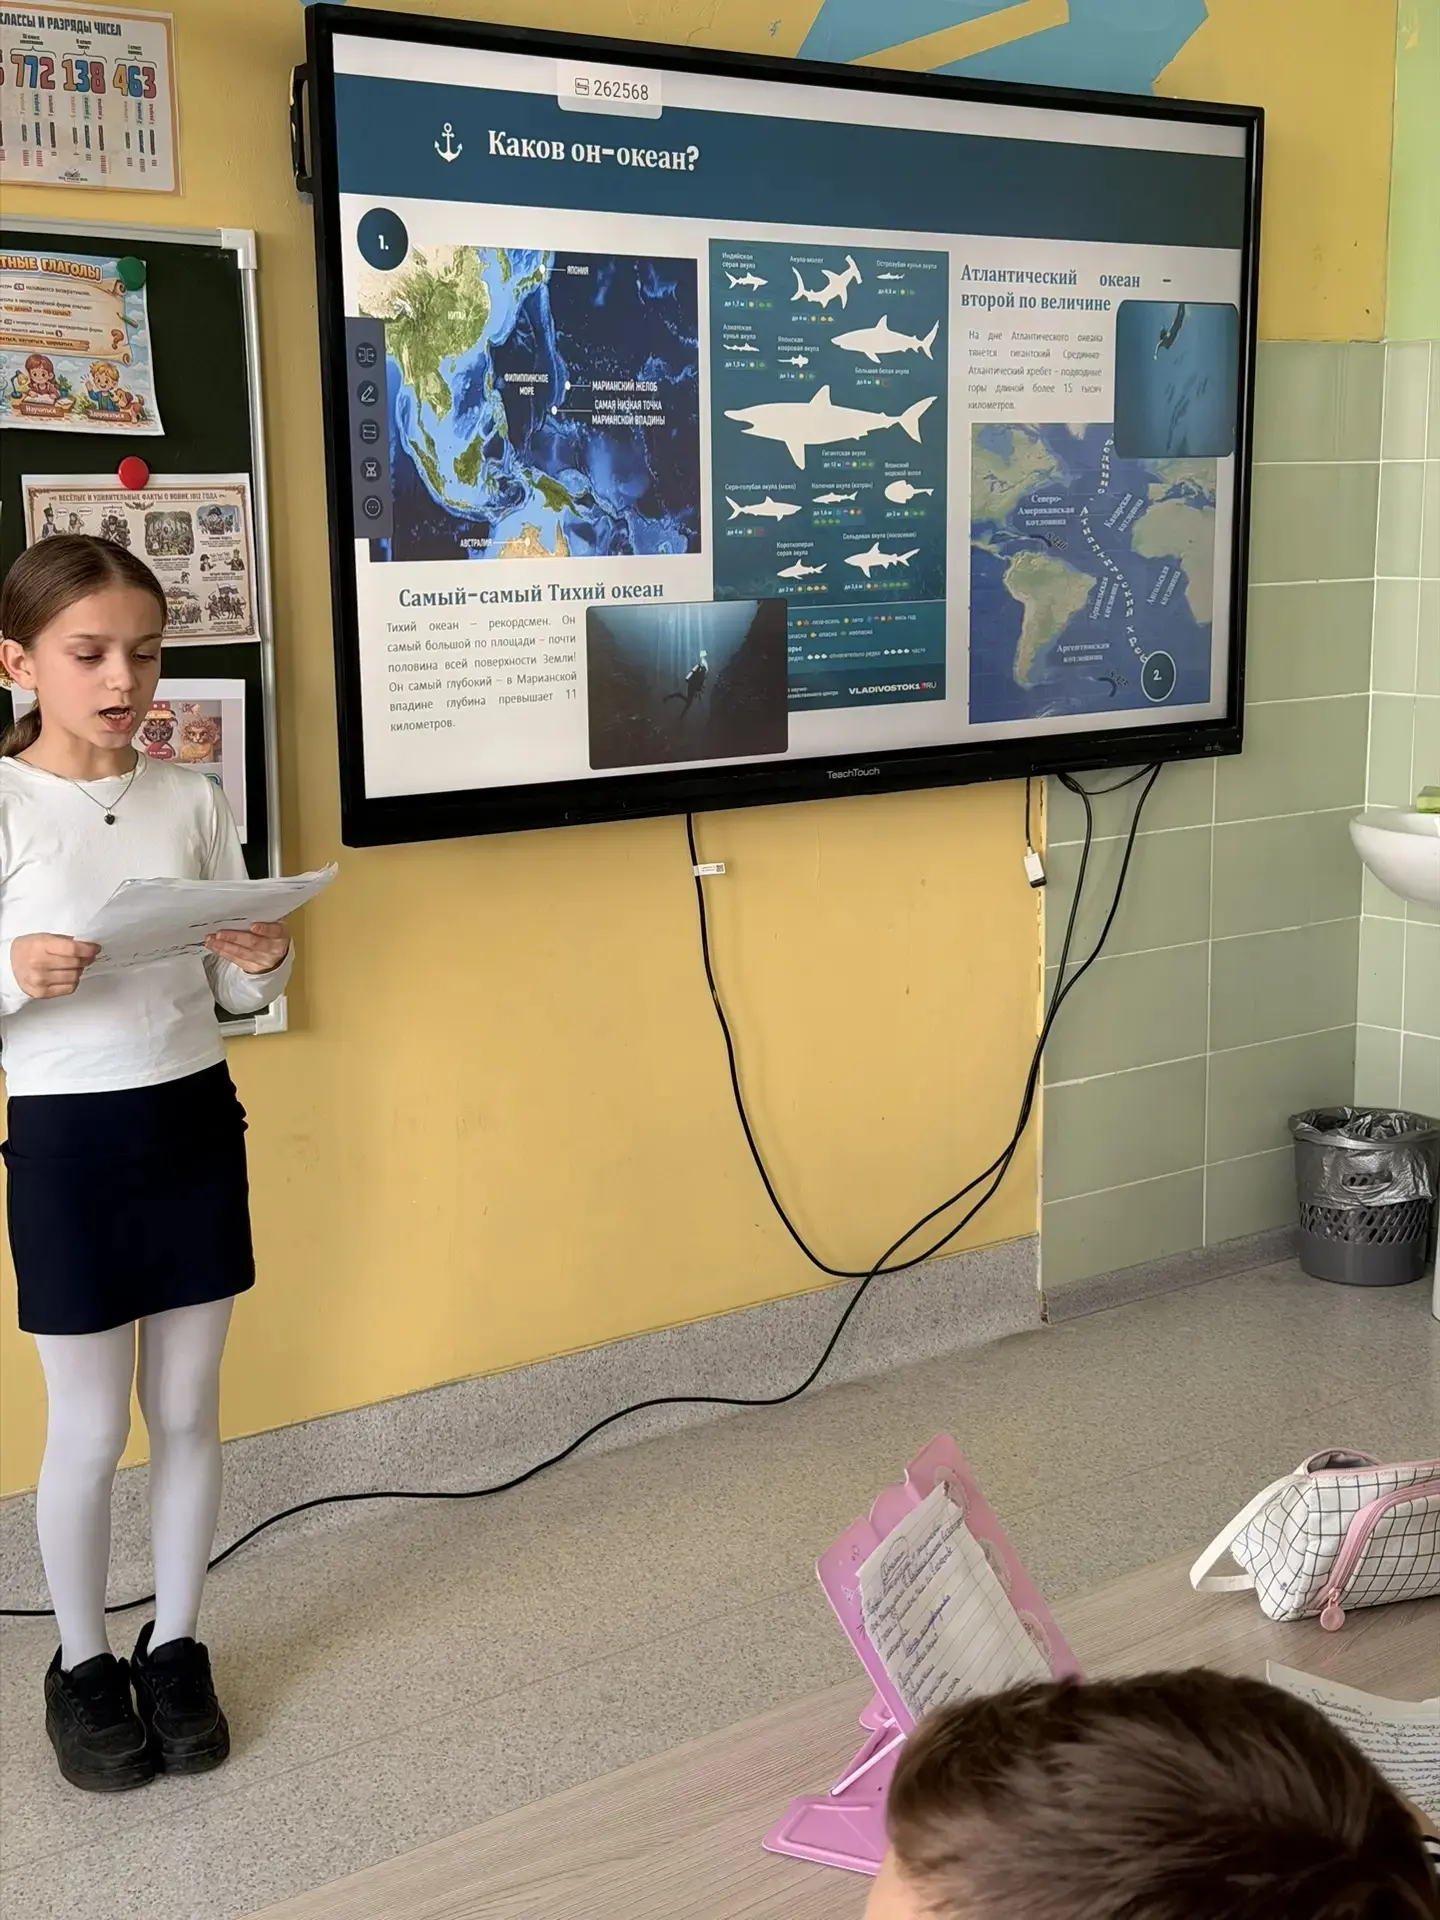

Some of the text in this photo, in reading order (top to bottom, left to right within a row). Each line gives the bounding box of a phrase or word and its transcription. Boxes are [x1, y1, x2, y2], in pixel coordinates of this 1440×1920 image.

[38, 16, 45, 28] И
[47, 17, 92, 34] РАЗРЯДЫ
[94, 22, 122, 36] ЧИСЕЛ
[10, 54, 157, 99] 772 138 463
[594, 79, 649, 101] 262568
[488, 130, 699, 172] Каков он-океан?
[0, 255, 100, 281] ТНЫЕ ГЛАГОЛЫ
[567, 266, 589, 275] ЯПОНИЯ
[961, 264, 1140, 288] Атлантический океан
[961, 292, 1110, 311] второй по величине
[969, 331, 979, 340] На
[988, 332, 1002, 341] дне
[1011, 331, 1069, 342] Атлантического
[968, 349, 997, 357] тянется
[1010, 349, 1051, 358] гигантский
[504, 373, 549, 383] ФИЛИППИНСКОЕ
[968, 366, 1102, 377] Атлантический хребет подводные
[519, 386, 535, 396] МОРЕ
[592, 380, 658, 392] МАРИАНСКИЙ ЖЕЛОБ
[968, 385, 987, 394] горы
[1033, 383, 1055, 393] более
[1064, 384, 1073, 393] 15
[594, 399, 662, 411] САМАЯ НИЗКАЯ ТОЧКА
[968, 400, 1016, 411] километров.
[592, 414, 665, 426] МАРИАНСКОЙ ВПАДИНЫ
[460, 538, 493, 548] АВСТРАЛИЯ
[399, 583, 664, 607] Самый-самый Тихий океан
[386, 615, 576, 633] Тихий океан рекордсмен. Он
[387, 635, 576, 652] самый большой по площади почти
[388, 652, 576, 673] половина всей поверхности Земли!
[389, 672, 577, 692] Он самый глубокий в Марианской
[390, 689, 577, 713] впадине глубина превышает 11
[390, 719, 456, 732] километров.
[826, 767, 880, 779] TeachTouch
